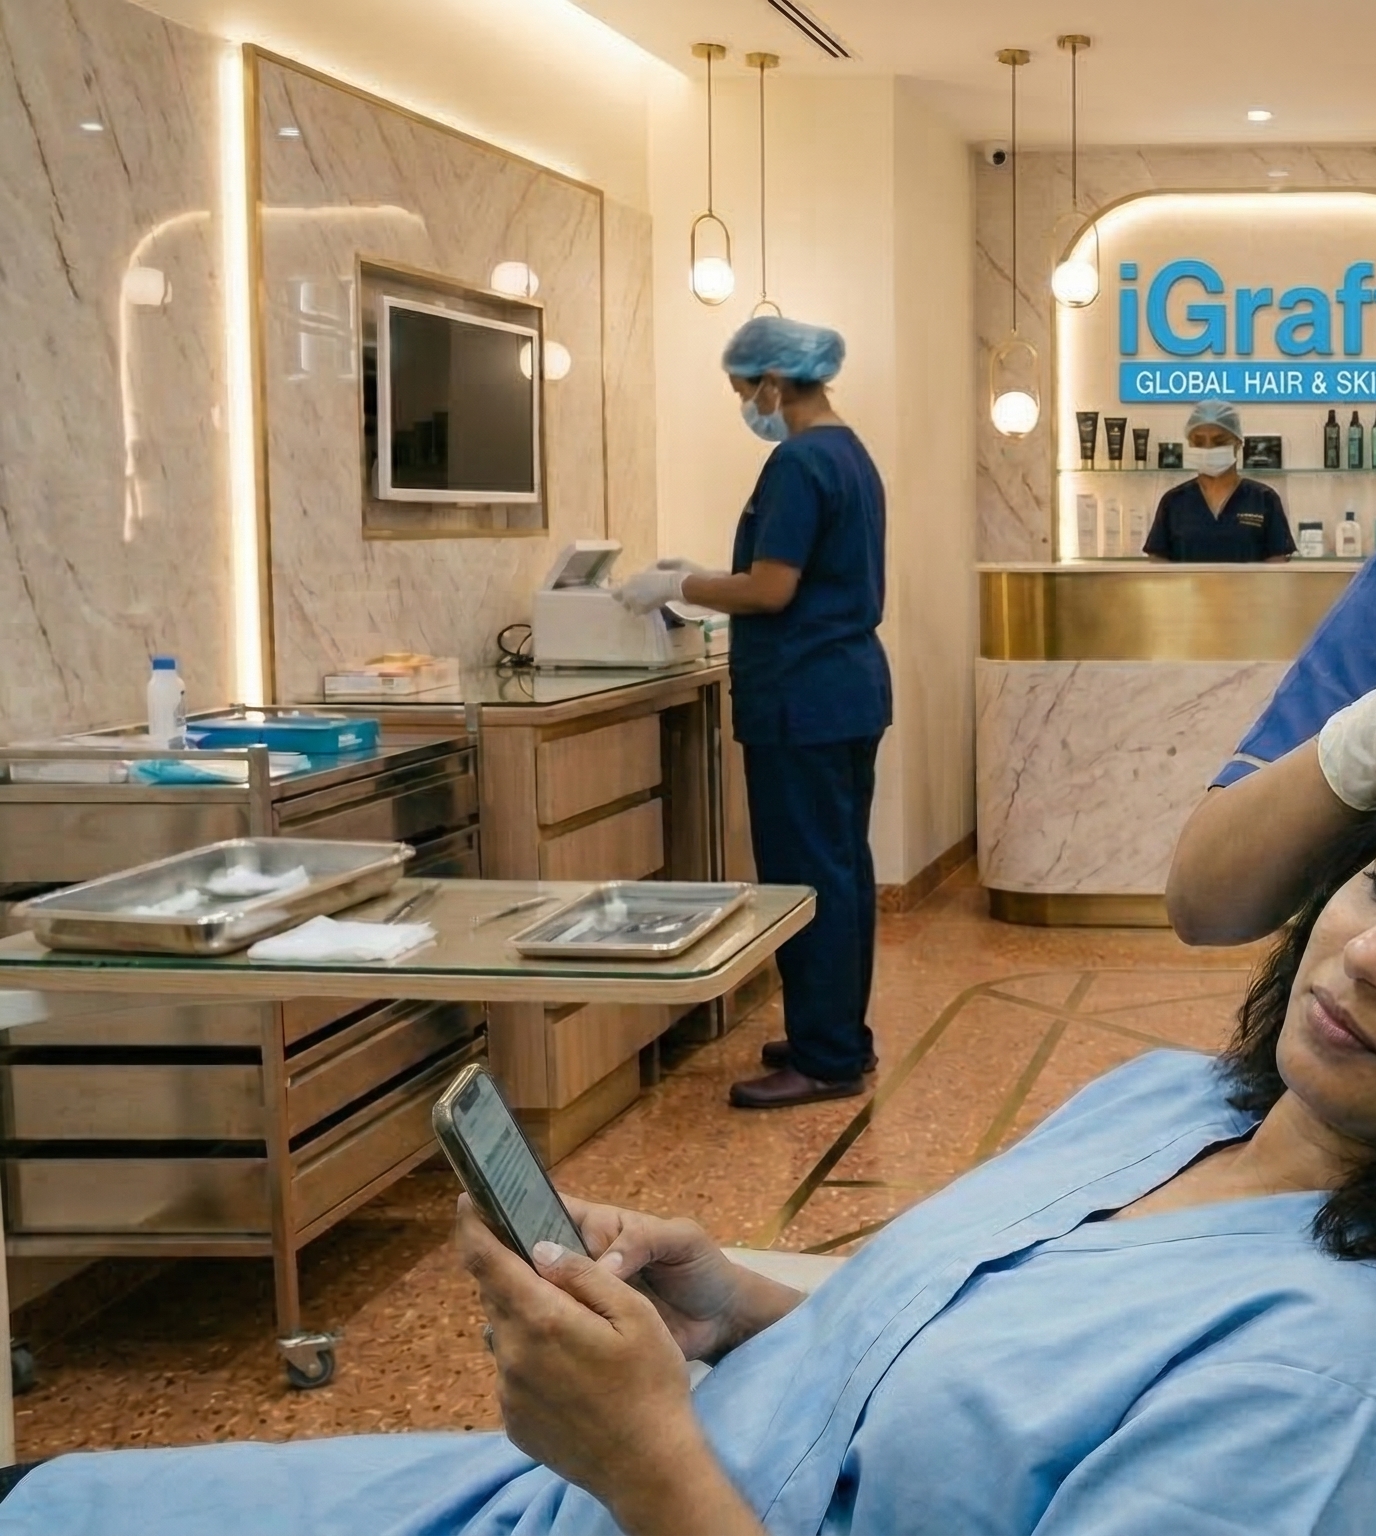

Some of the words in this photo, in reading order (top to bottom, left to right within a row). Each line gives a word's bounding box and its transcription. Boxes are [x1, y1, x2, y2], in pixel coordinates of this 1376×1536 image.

[1135, 370, 1235, 394] GLOBAL
[1245, 371, 1303, 394] HAIR
[1311, 371, 1328, 394] &
